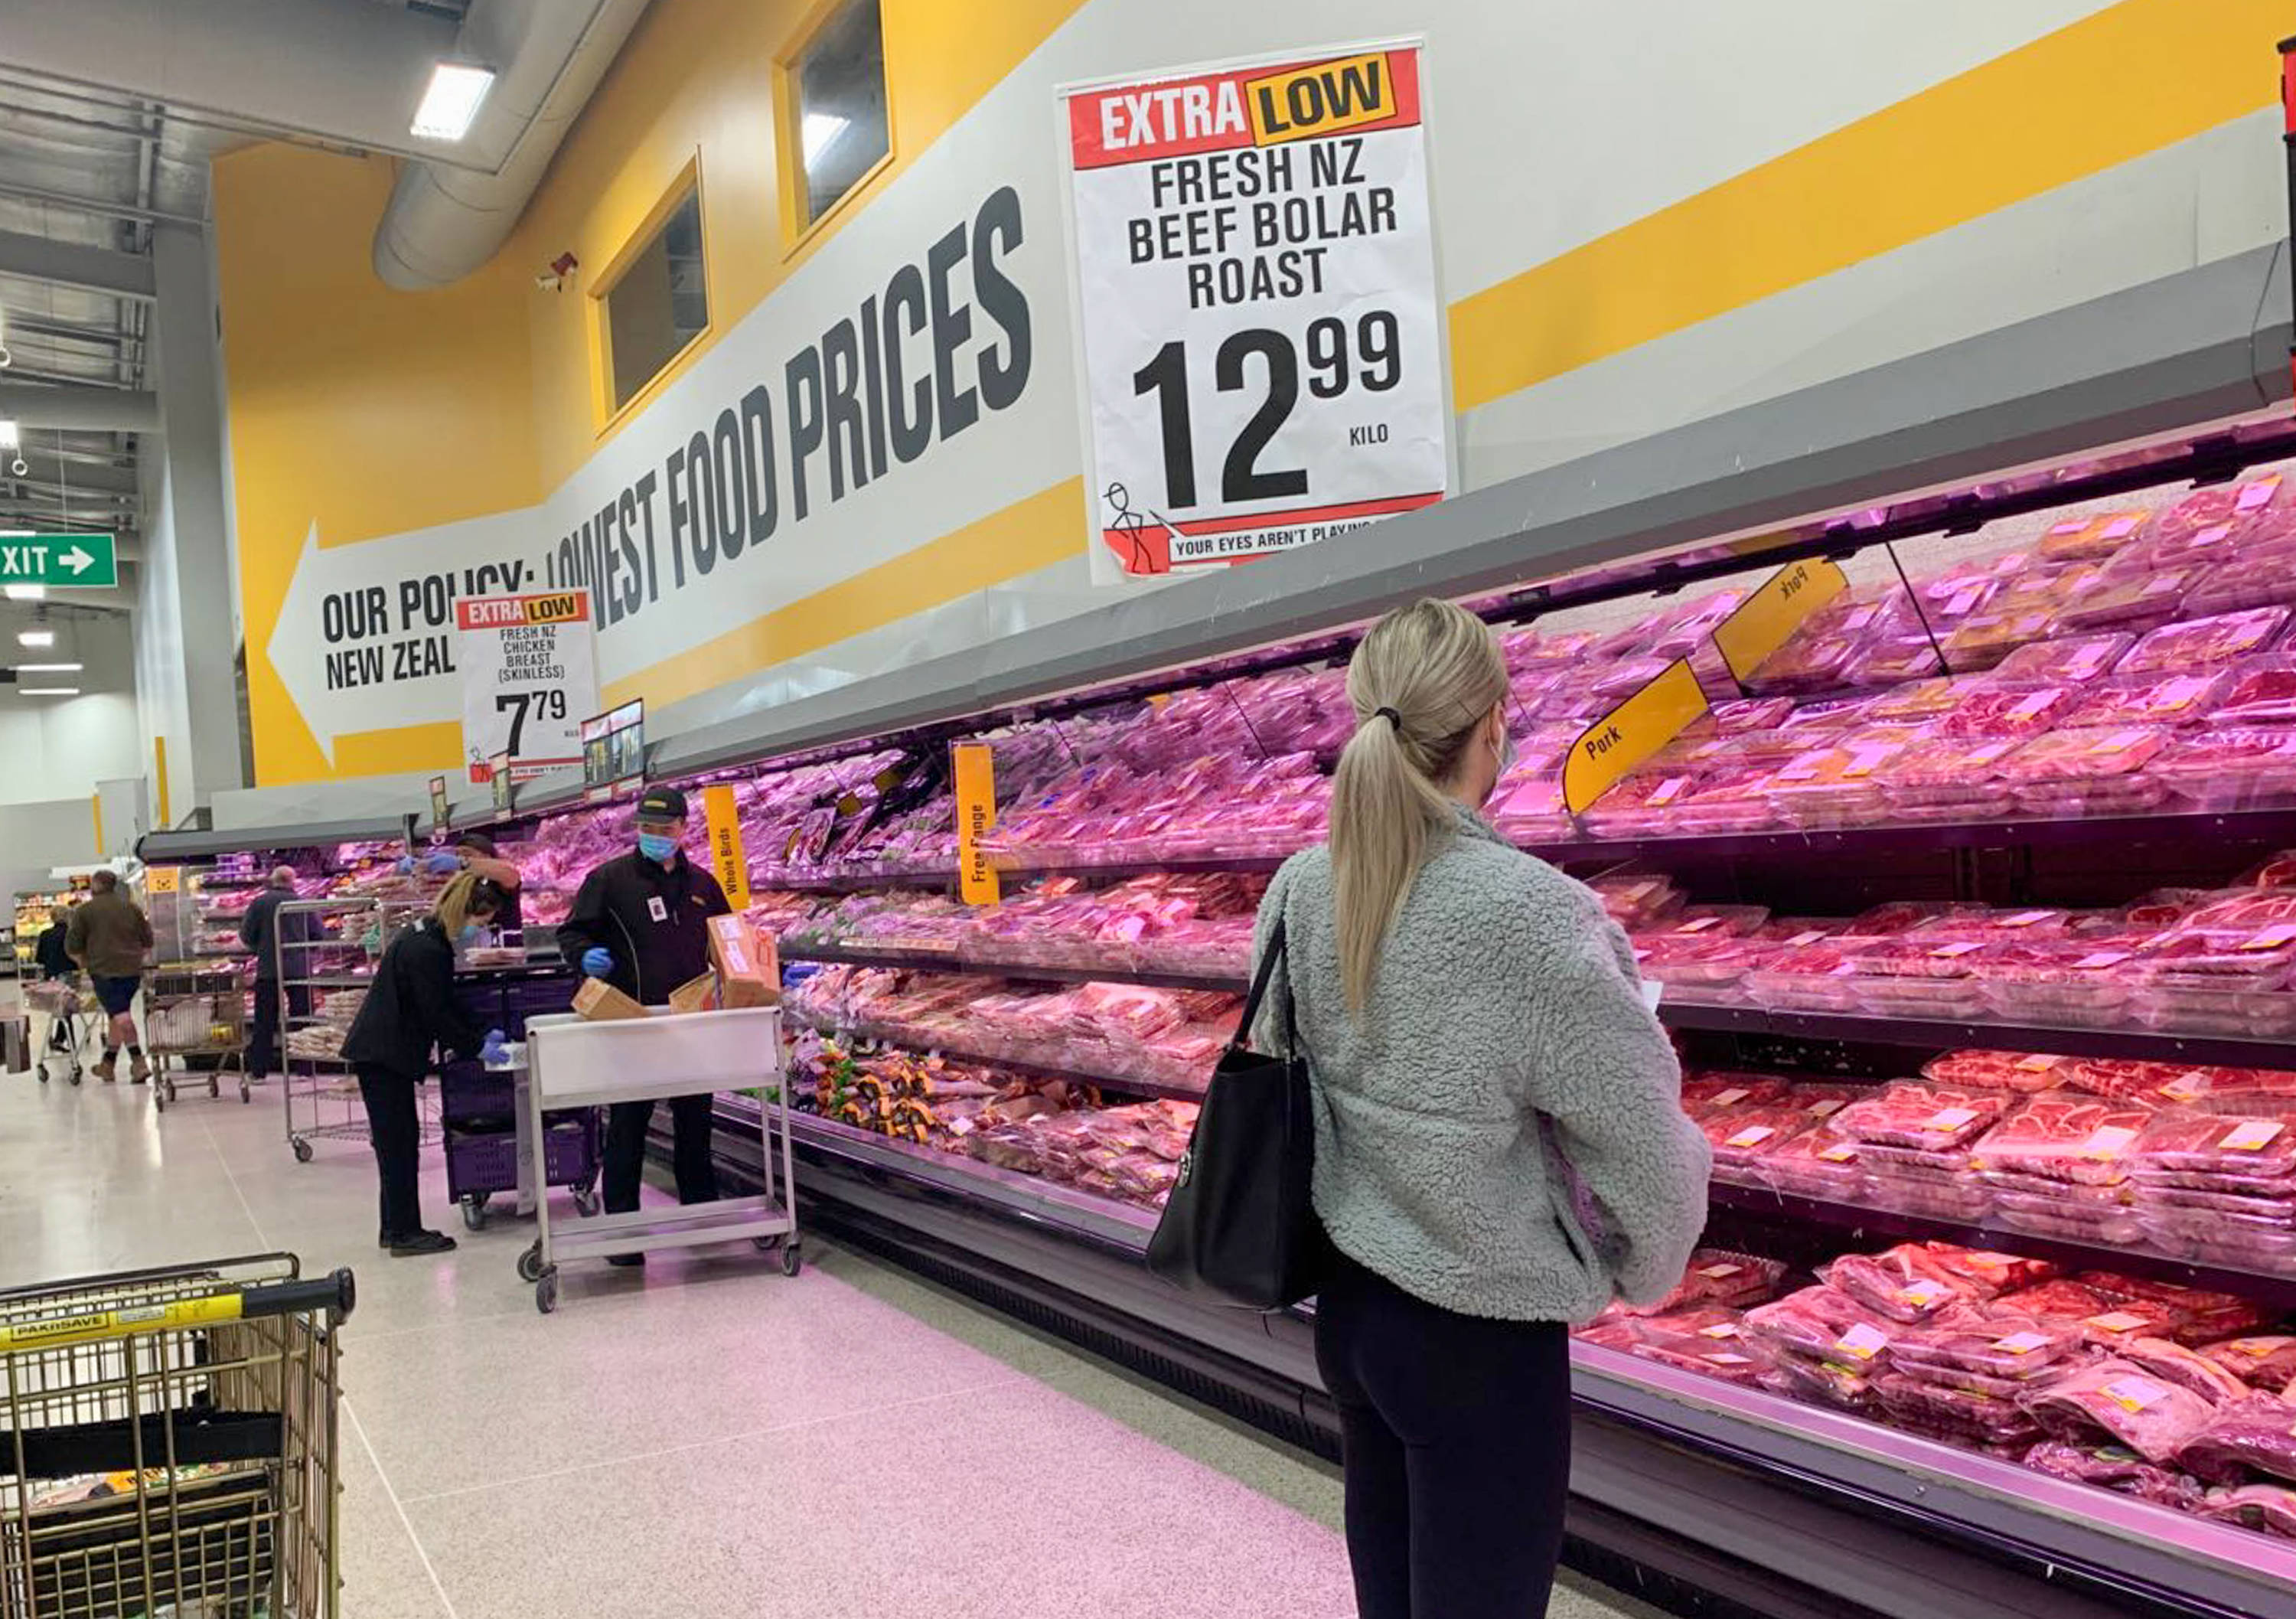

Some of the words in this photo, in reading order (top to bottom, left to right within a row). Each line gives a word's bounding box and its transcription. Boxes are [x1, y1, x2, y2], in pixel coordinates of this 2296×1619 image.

[1100, 80, 1246, 151] EXTRA
[1258, 60, 1381, 135] LOW
[1151, 148, 1293, 208] FRESH
[1310, 139, 1365, 189] NZ
[1128, 207, 1237, 264] BEEF
[1253, 187, 1397, 247] BOLAR
[1188, 248, 1327, 308] ROAST
[667, 384, 778, 589] FOOD
[785, 185, 1032, 522] PRICES
[1349, 424, 1389, 446] KILO
[1176, 539, 1213, 556] YOUR
[1219, 535, 1253, 551] EYES
[1258, 529, 1306, 547] AREN'T
[2, 546, 49, 575] XIT
[323, 586, 388, 642] OUR
[468, 599, 525, 624] EXTRA
[528, 596, 575, 621] LOW
[500, 627, 539, 641] FRESH
[541, 625, 556, 638] NZ
[503, 639, 555, 654] CHICKEN
[326, 645, 383, 690] NEW
[393, 635, 456, 681] ZEAL
[498, 665, 565, 684] (SKINLESS)
[506, 653, 551, 668] BREAST
[496, 693, 530, 756] 7
[1585, 725, 1623, 760] Pork
[718, 827, 732, 857] Birds
[723, 860, 738, 896] Whole
[971, 852, 986, 883] Free
